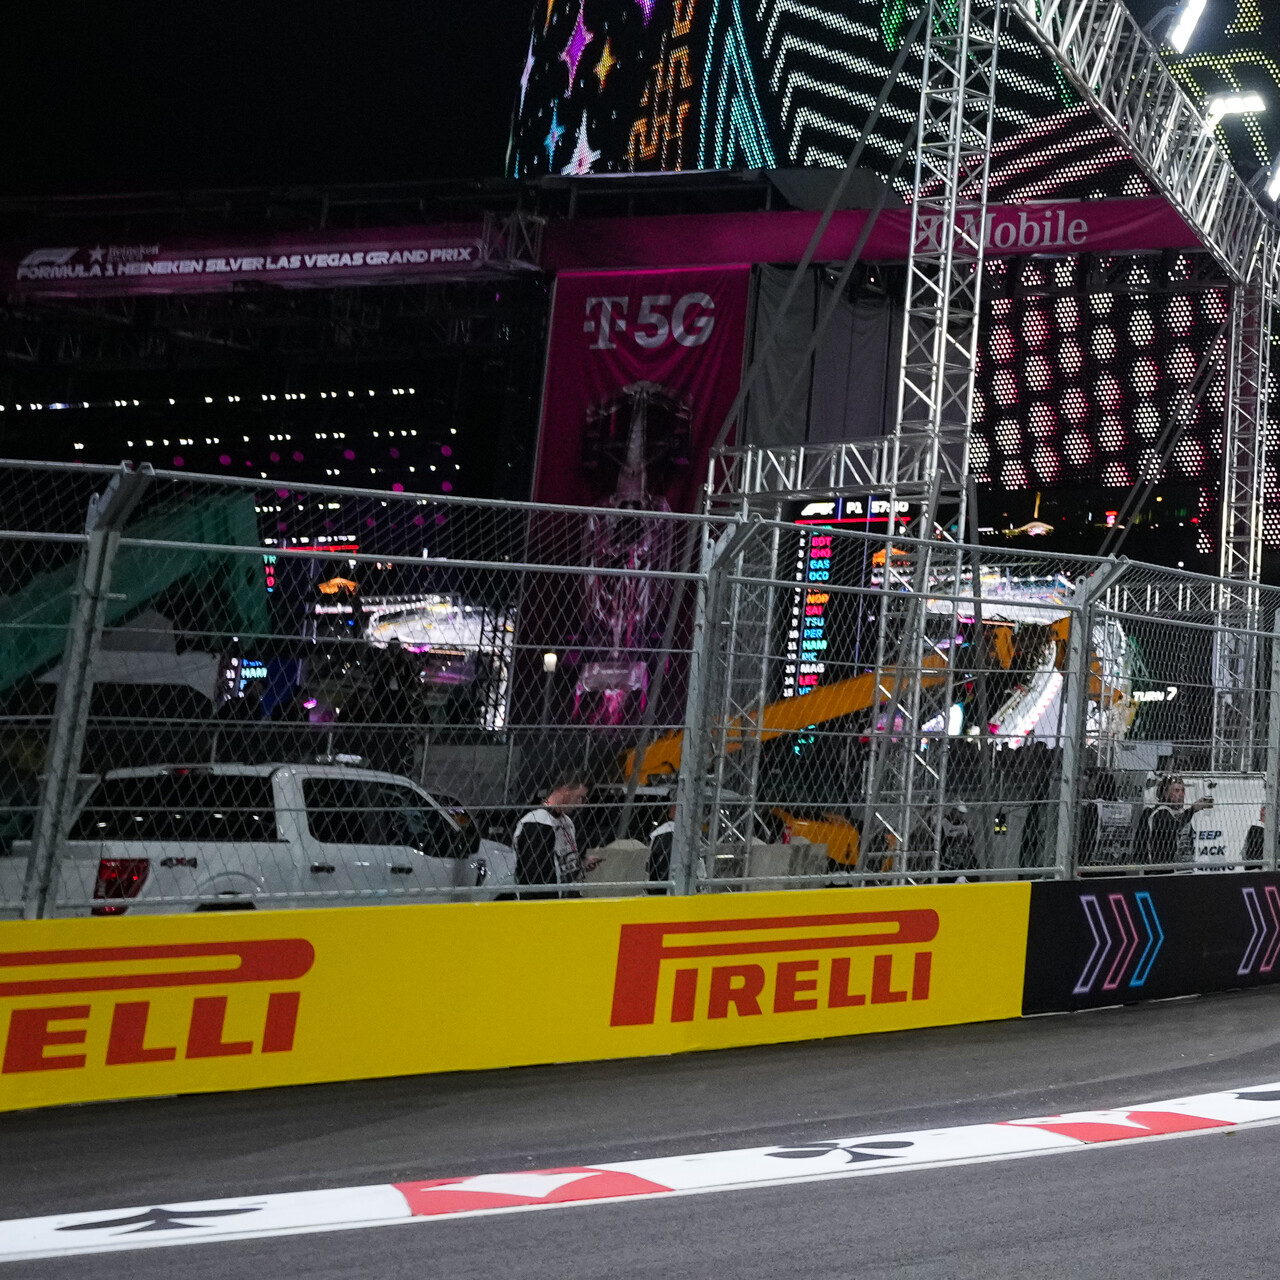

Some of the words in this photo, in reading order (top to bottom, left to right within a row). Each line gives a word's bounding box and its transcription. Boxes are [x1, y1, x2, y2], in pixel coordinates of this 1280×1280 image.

[959, 209, 1089, 250] Mobile
[117, 260, 202, 277] HEINEKEN
[206, 256, 265, 272] SILVER
[266, 255, 302, 270] LAS
[304, 252, 365, 268] VEGAS
[366, 250, 428, 265] GRAND
[430, 248, 473, 262] PRIX
[634, 292, 715, 348] 5G
[805, 605, 823, 616] SAI
[804, 628, 823, 639] PER
[802, 640, 828, 650] HAM
[800, 663, 825, 673] MAG
[798, 674, 818, 686] LEC
[1132, 690, 1164, 702] TURN
[1166, 687, 1178, 701] 7
[609, 908, 940, 1027] PIRELLI
[0, 937, 315, 1074] ELLI
